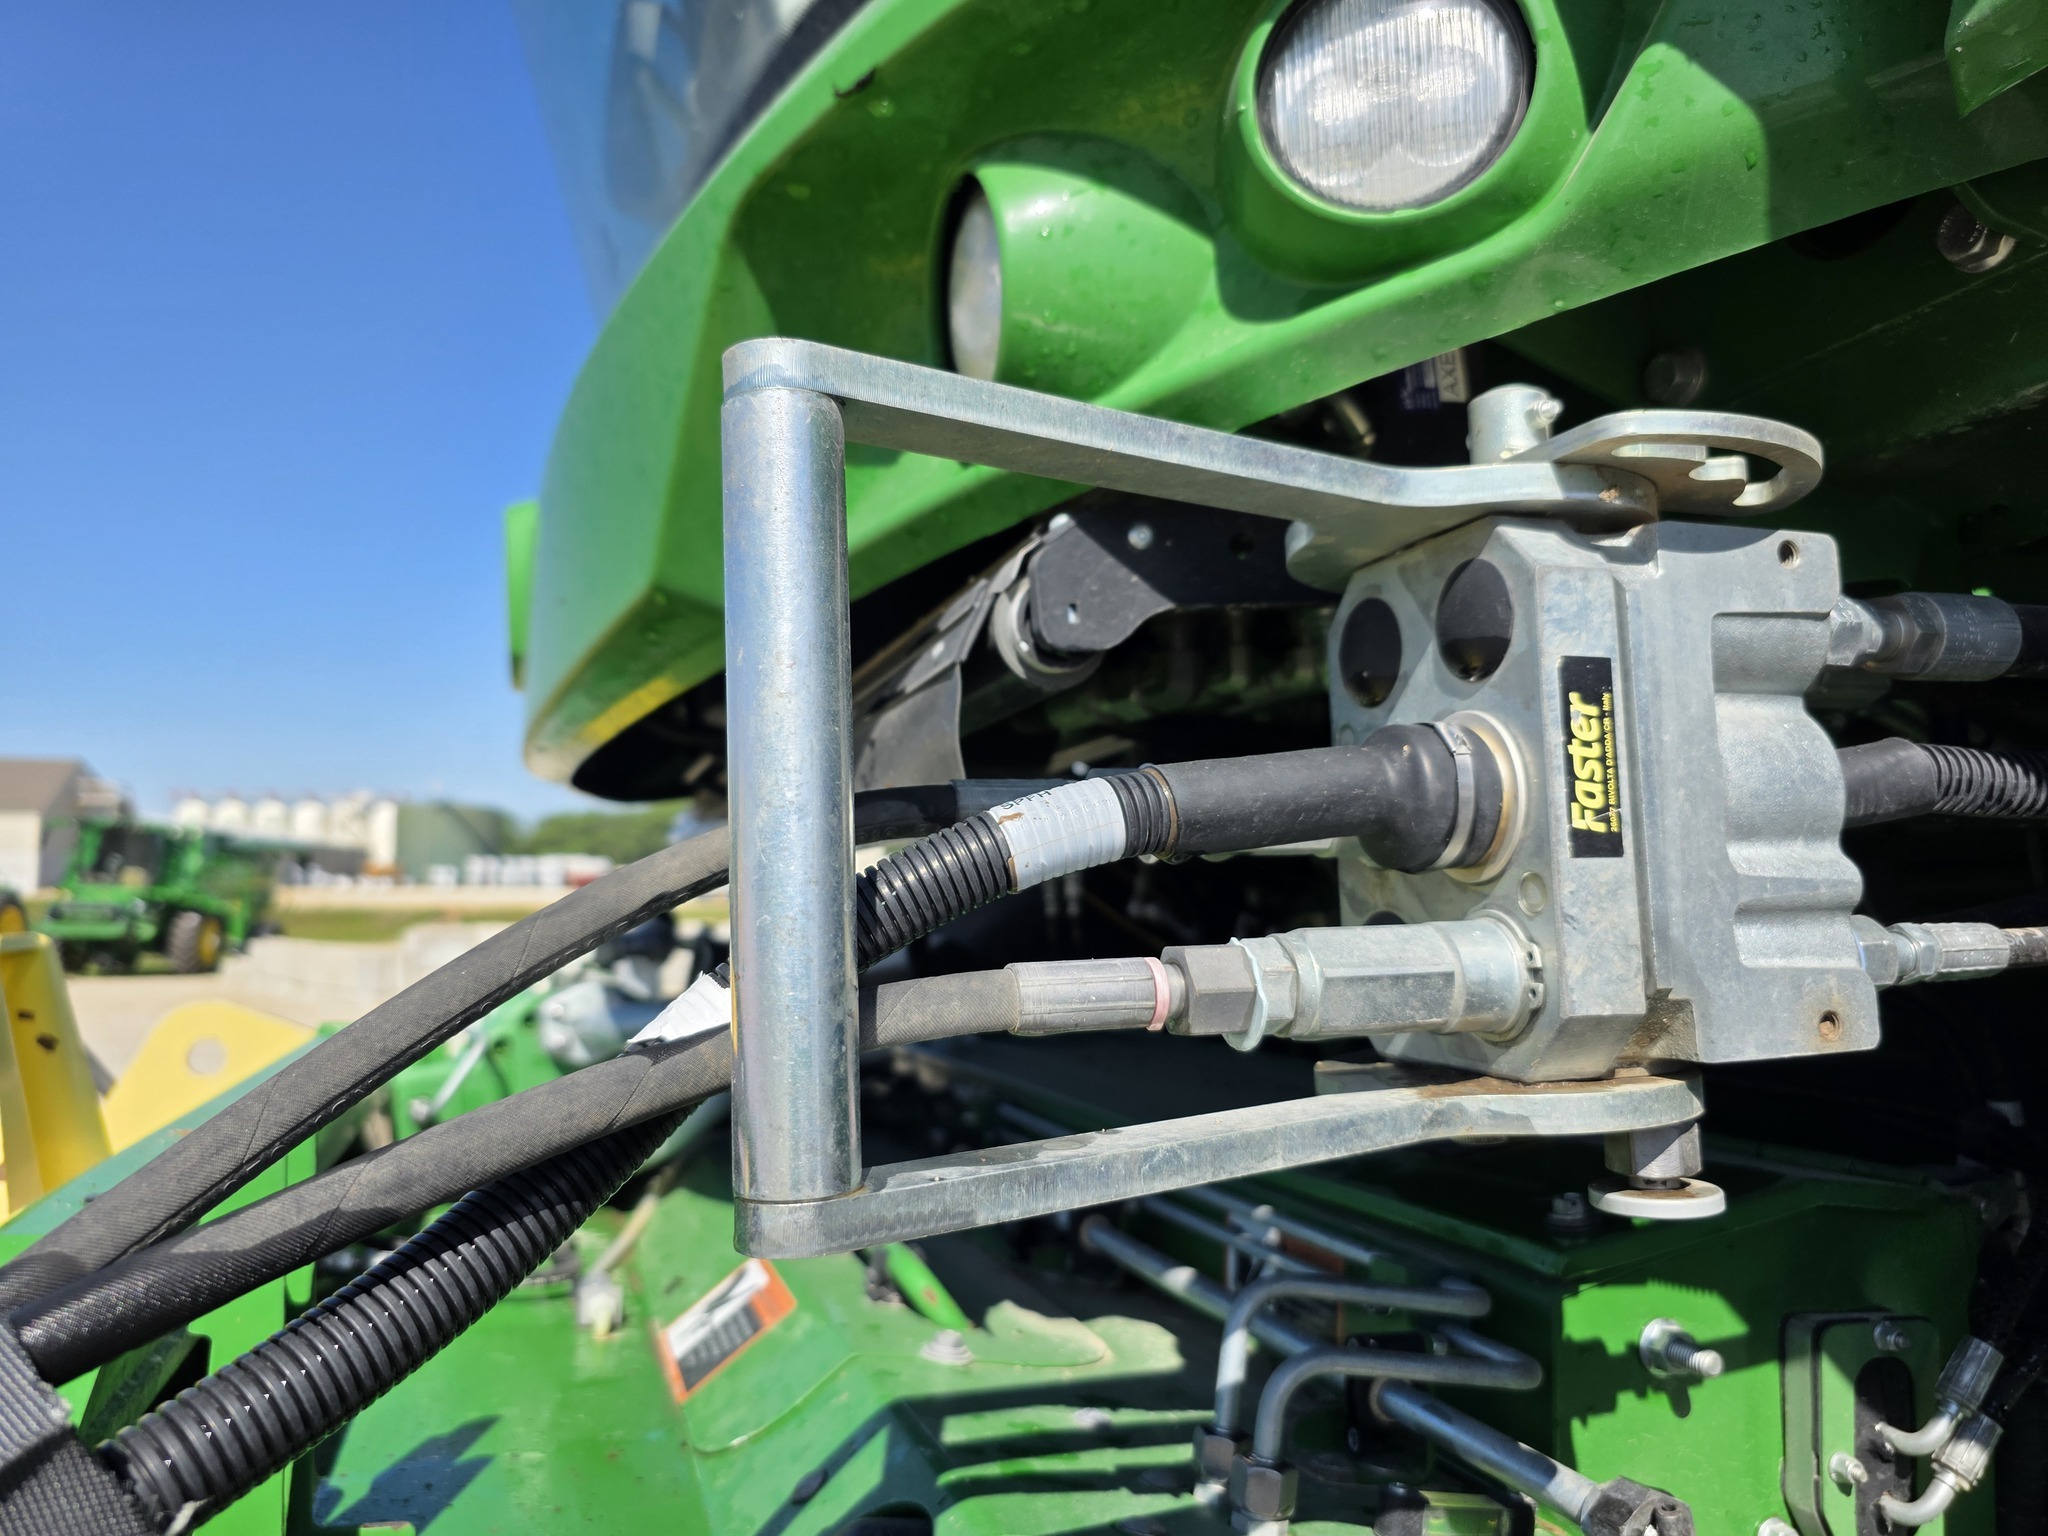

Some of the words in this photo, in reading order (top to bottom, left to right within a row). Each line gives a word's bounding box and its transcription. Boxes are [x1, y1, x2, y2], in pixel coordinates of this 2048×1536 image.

[1602, 692, 1611, 711] Italy
[1567, 691, 1607, 834] Faster
[1607, 768, 1617, 805] RIVOLTA
